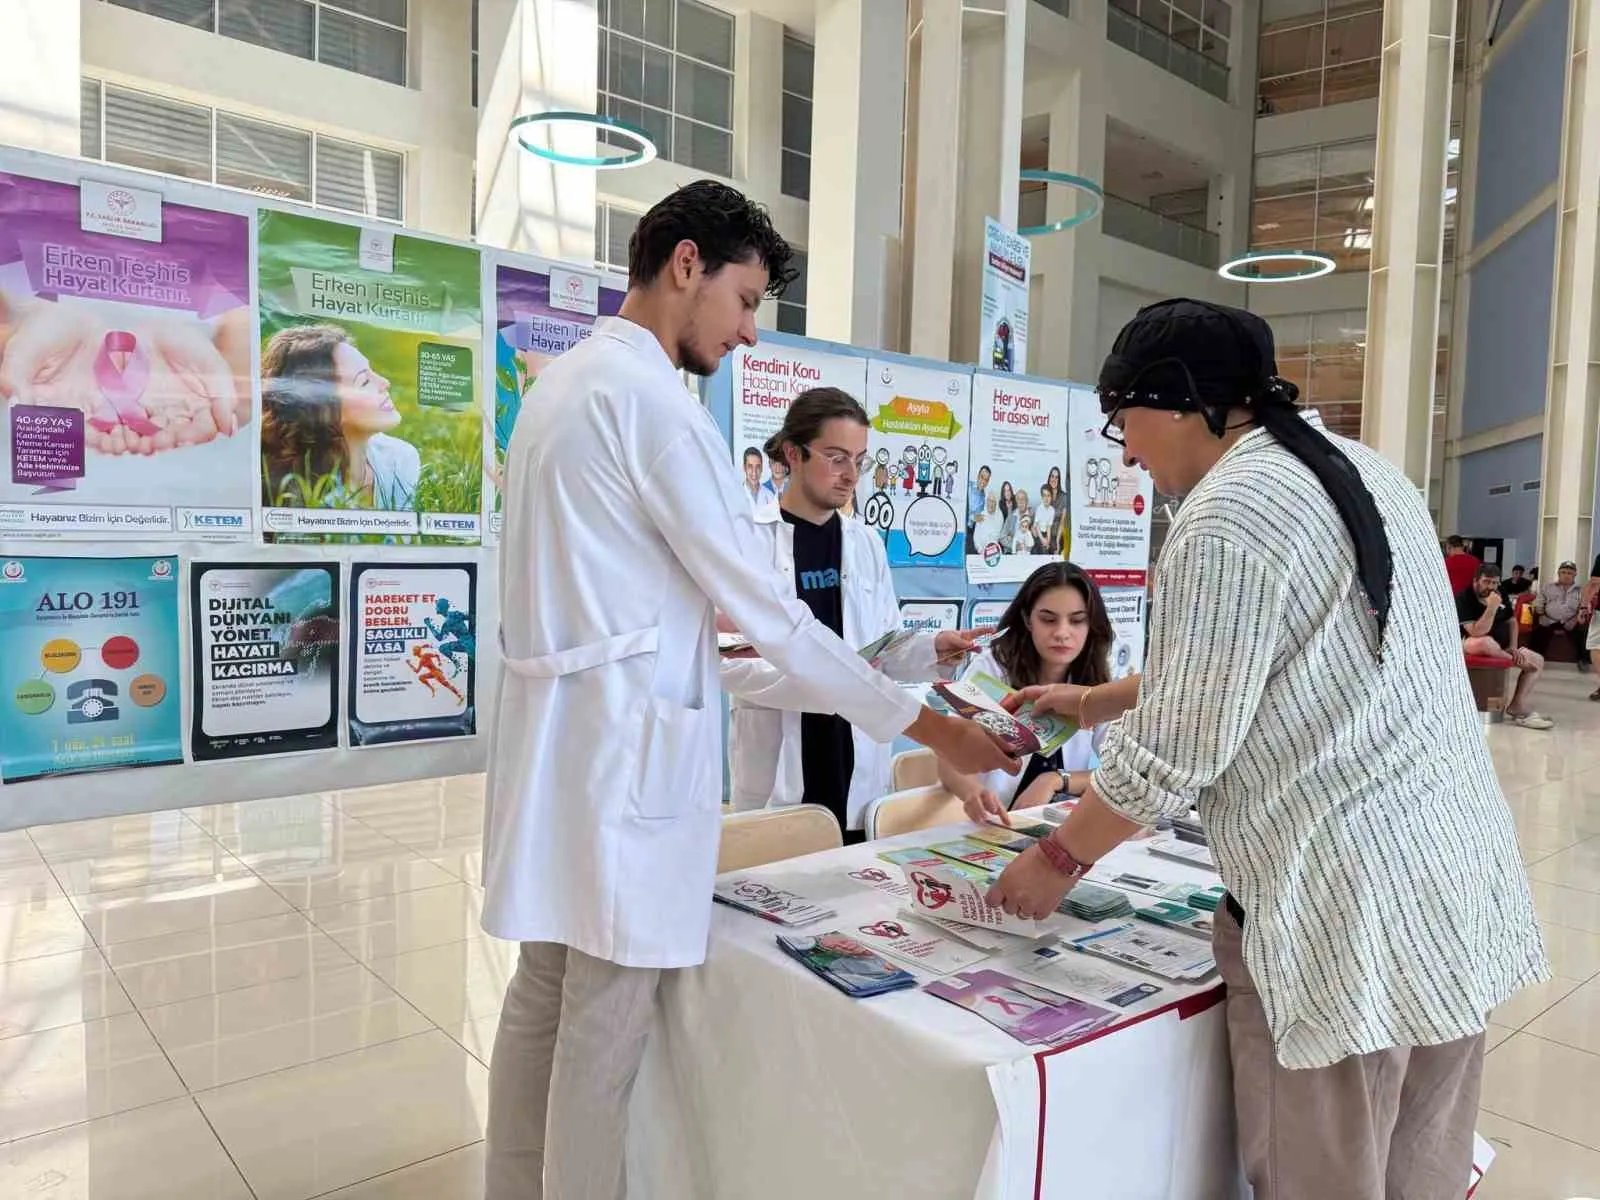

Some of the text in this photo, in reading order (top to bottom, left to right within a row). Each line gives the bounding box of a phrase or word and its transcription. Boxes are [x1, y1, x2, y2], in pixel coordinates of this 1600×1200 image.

[45, 245, 189, 283] Erken Teşhis
[45, 268, 107, 291] Hayat
[312, 272, 366, 296] Erken
[311, 293, 362, 314] Hayat
[532, 316, 569, 337] Erken
[531, 334, 565, 352] Hayat
[743, 353, 821, 380] Kendini Koru
[742, 371, 787, 393] Hastanı
[742, 388, 791, 409] Ertelem
[993, 388, 1012, 406] Her
[16, 416, 73, 429] 40-69 YAŞ
[992, 405, 1006, 423] bir
[1031, 411, 1050, 428] var!
[16, 454, 47, 462] KETEM
[31, 512, 77, 523] Hayatınız
[79, 513, 105, 522] Bizim
[194, 515, 243, 525] KETEM
[336, 517, 359, 526] Bizim
[434, 519, 475, 530] KETEM
[800, 567, 840, 590] ma
[36, 591, 140, 611] ALO 191
[365, 595, 418, 604] HAREKET
[209, 610, 291, 626] DÜNYANI
[214, 644, 275, 660] HAYATI
